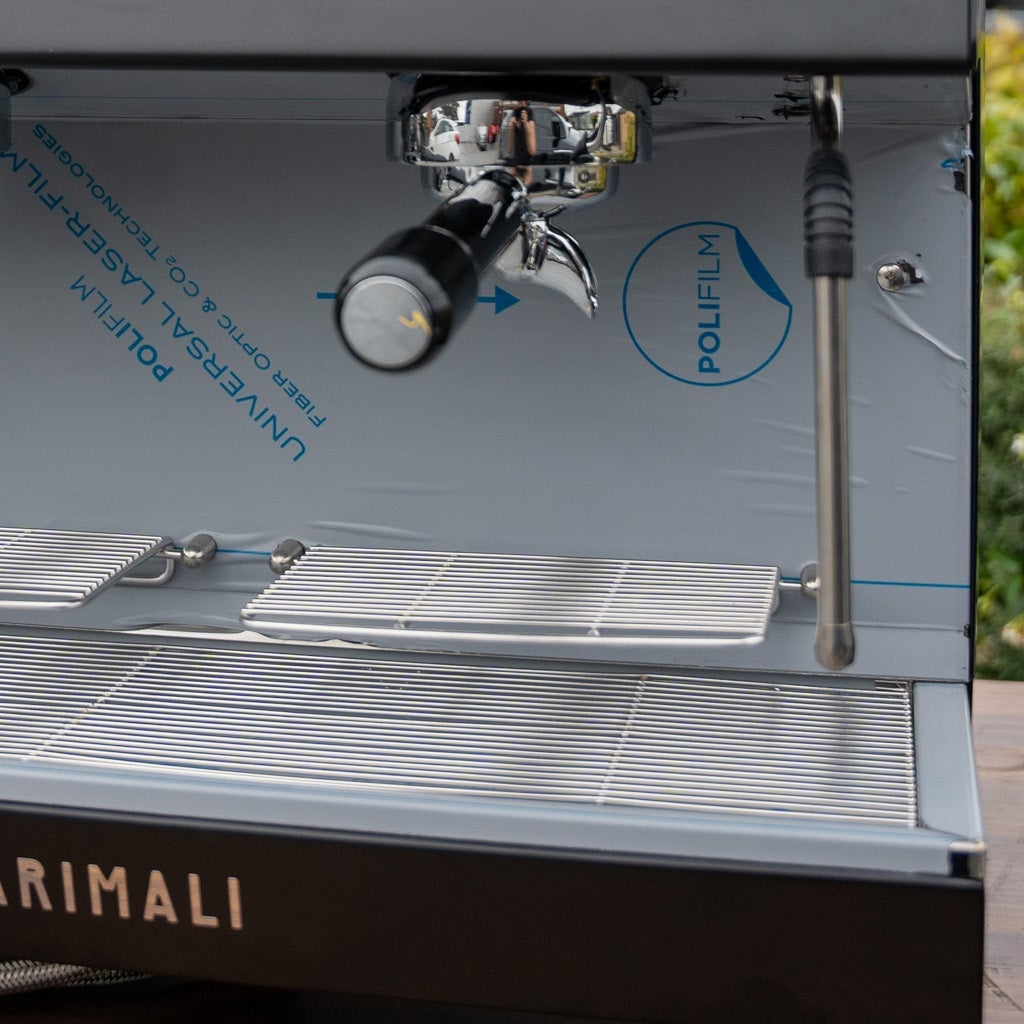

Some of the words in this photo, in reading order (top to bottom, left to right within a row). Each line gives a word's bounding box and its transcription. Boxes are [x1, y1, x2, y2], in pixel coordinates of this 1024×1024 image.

[32, 123, 158, 260] TECHNOLOGIES
[69, 274, 175, 383] POLIFILM
[202, 297, 218, 313] &
[217, 314, 272, 372] OPTIC
[697, 233, 721, 374] POLIFILM
[161, 300, 307, 462] UNIVERSAL
[271, 370, 327, 428] FIBER
